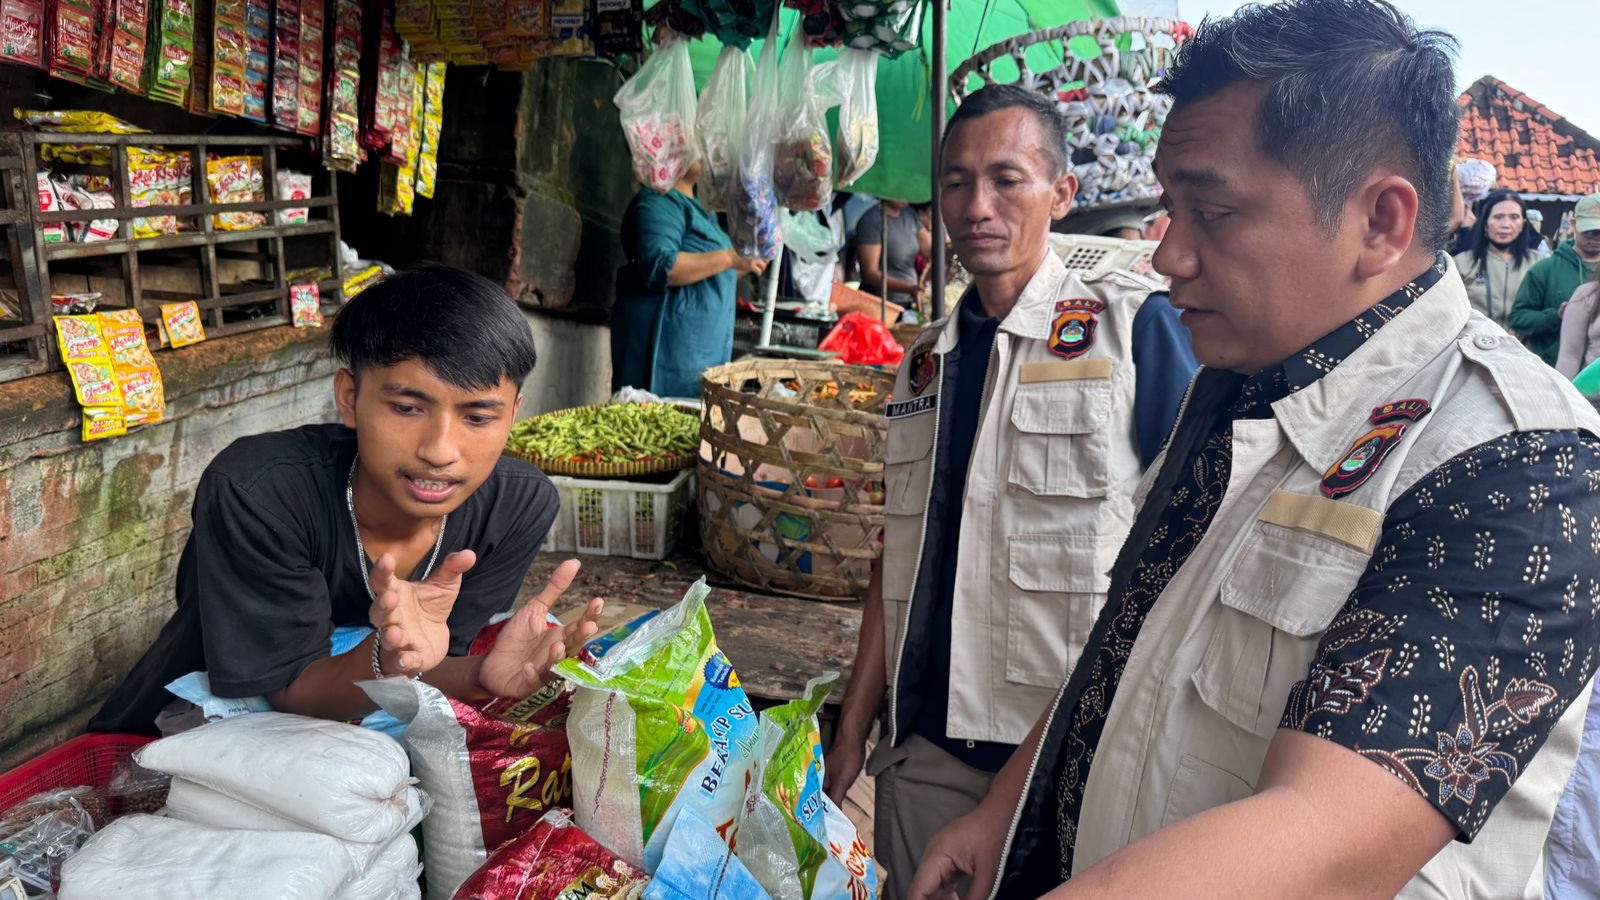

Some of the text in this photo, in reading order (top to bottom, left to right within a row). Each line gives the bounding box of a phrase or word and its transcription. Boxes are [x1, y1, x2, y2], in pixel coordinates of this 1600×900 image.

[892, 397, 931, 416] MANTRA
[1382, 401, 1423, 414] BALI
[508, 677, 566, 718] REMIU
